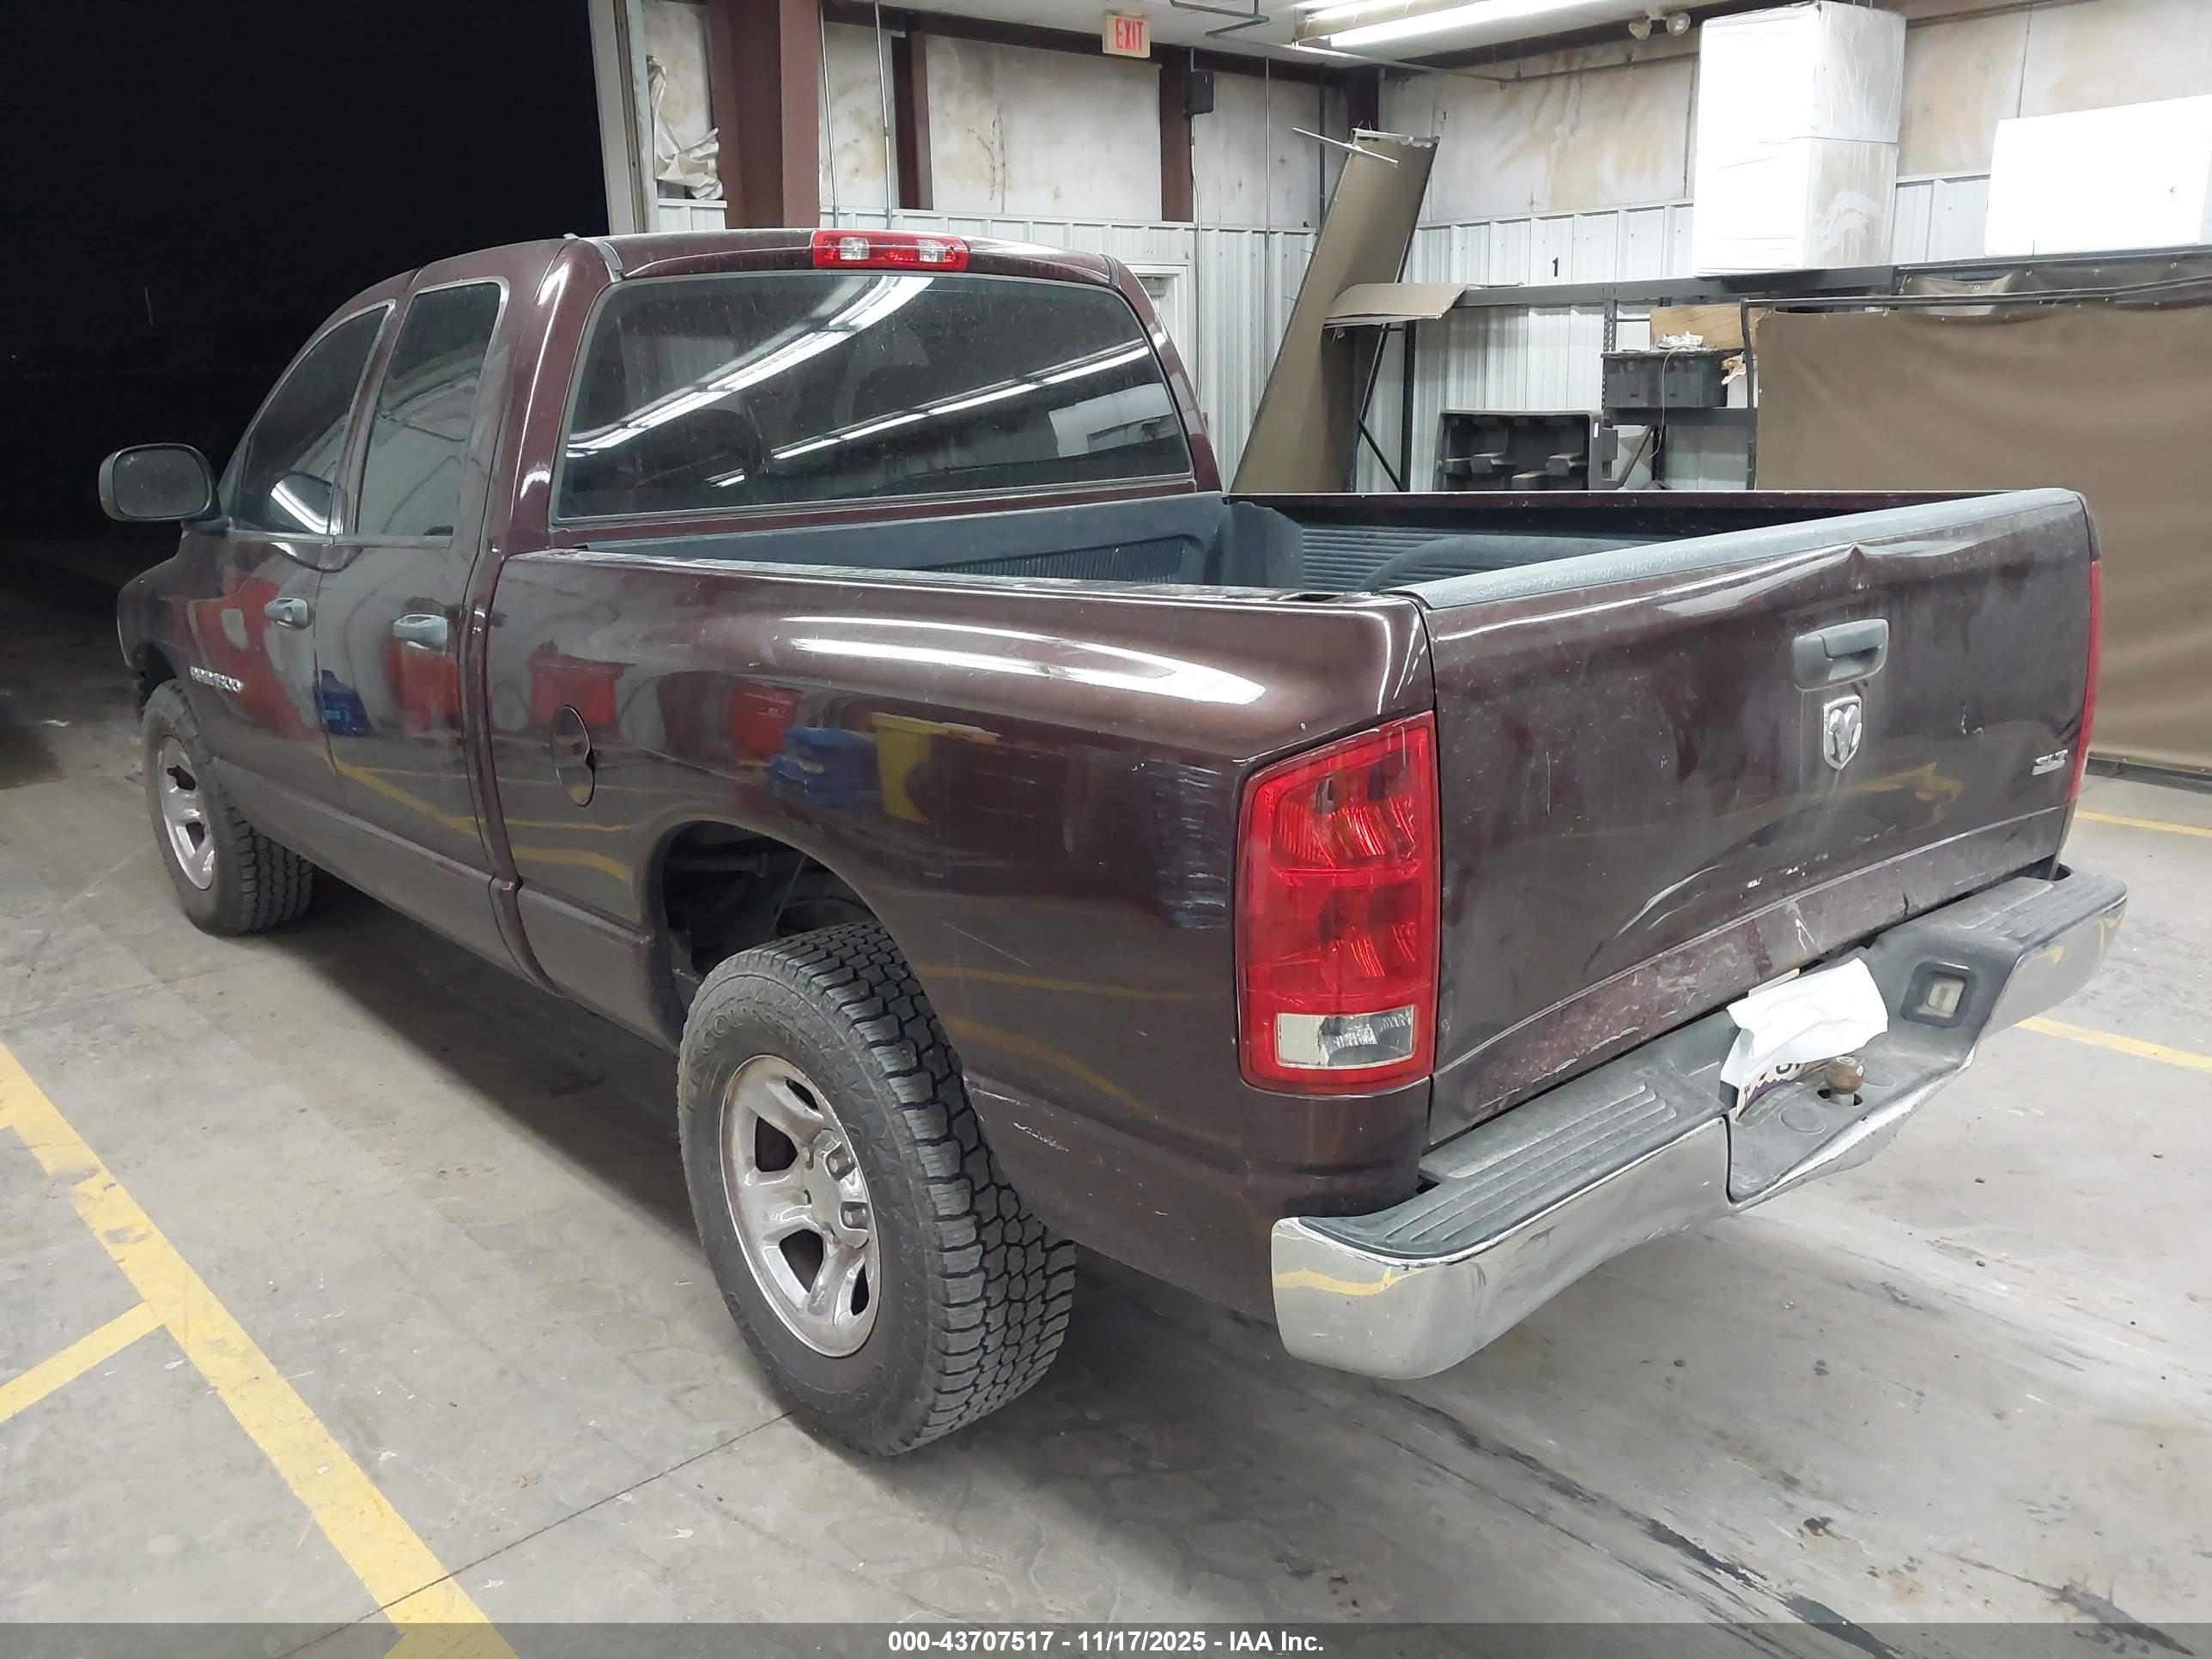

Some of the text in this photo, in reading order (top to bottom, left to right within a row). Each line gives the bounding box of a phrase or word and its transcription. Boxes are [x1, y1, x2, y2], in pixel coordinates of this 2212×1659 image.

[1115, 17, 1145, 52] EXIT
[1552, 257, 1559, 277] 1
[2032, 749, 2069, 776] SLT
